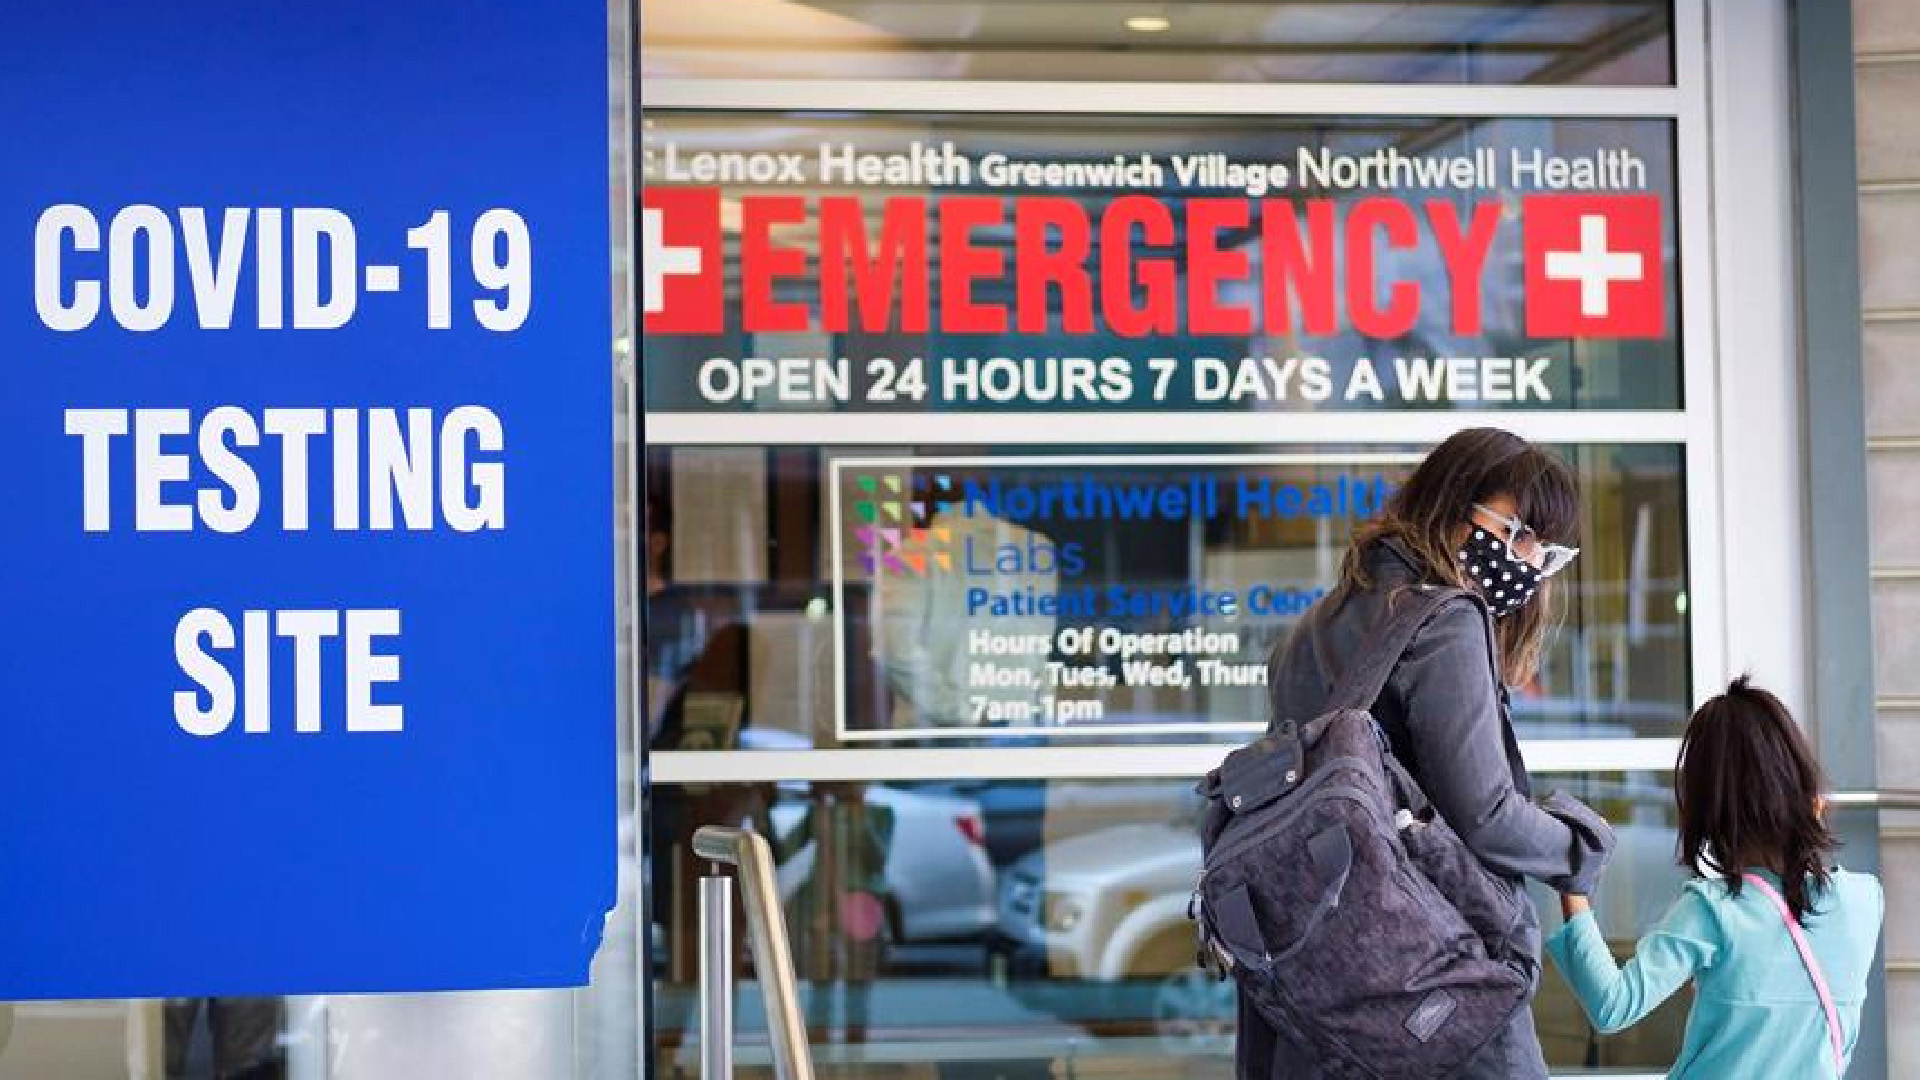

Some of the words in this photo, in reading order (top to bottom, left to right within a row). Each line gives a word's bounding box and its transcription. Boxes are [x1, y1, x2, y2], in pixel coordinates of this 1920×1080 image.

[664, 141, 805, 183] Lenox
[819, 141, 970, 186] Health
[979, 152, 1164, 188] Greenwich
[1171, 152, 1289, 196] Village
[1296, 147, 1496, 190] Northwell
[1511, 147, 1646, 190] Health
[35, 203, 532, 332] COVID-19
[740, 192, 1502, 340] EMERGENCY
[699, 357, 850, 402] OPEN
[866, 357, 927, 402] 24
[942, 357, 1133, 402] HOURS
[1148, 358, 1178, 401] 7
[1193, 357, 1332, 402] DAYS
[1345, 358, 1384, 401] A
[1394, 357, 1553, 402] WEEK
[64, 405, 506, 533] TESTING
[963, 473, 1217, 521] Northwell
[964, 530, 1086, 576] Labs
[968, 583, 1097, 617] Patient
[1106, 583, 1239, 617] Service
[968, 628, 1052, 656] Hours
[1057, 626, 1095, 656] Of
[1099, 626, 1240, 659] Operation
[173, 607, 403, 736] SITE
[969, 662, 1041, 691] Mon,
[1045, 661, 1117, 690] Tues,
[1122, 660, 1192, 691] Wed,
[969, 695, 1104, 725] 7am-1pm
